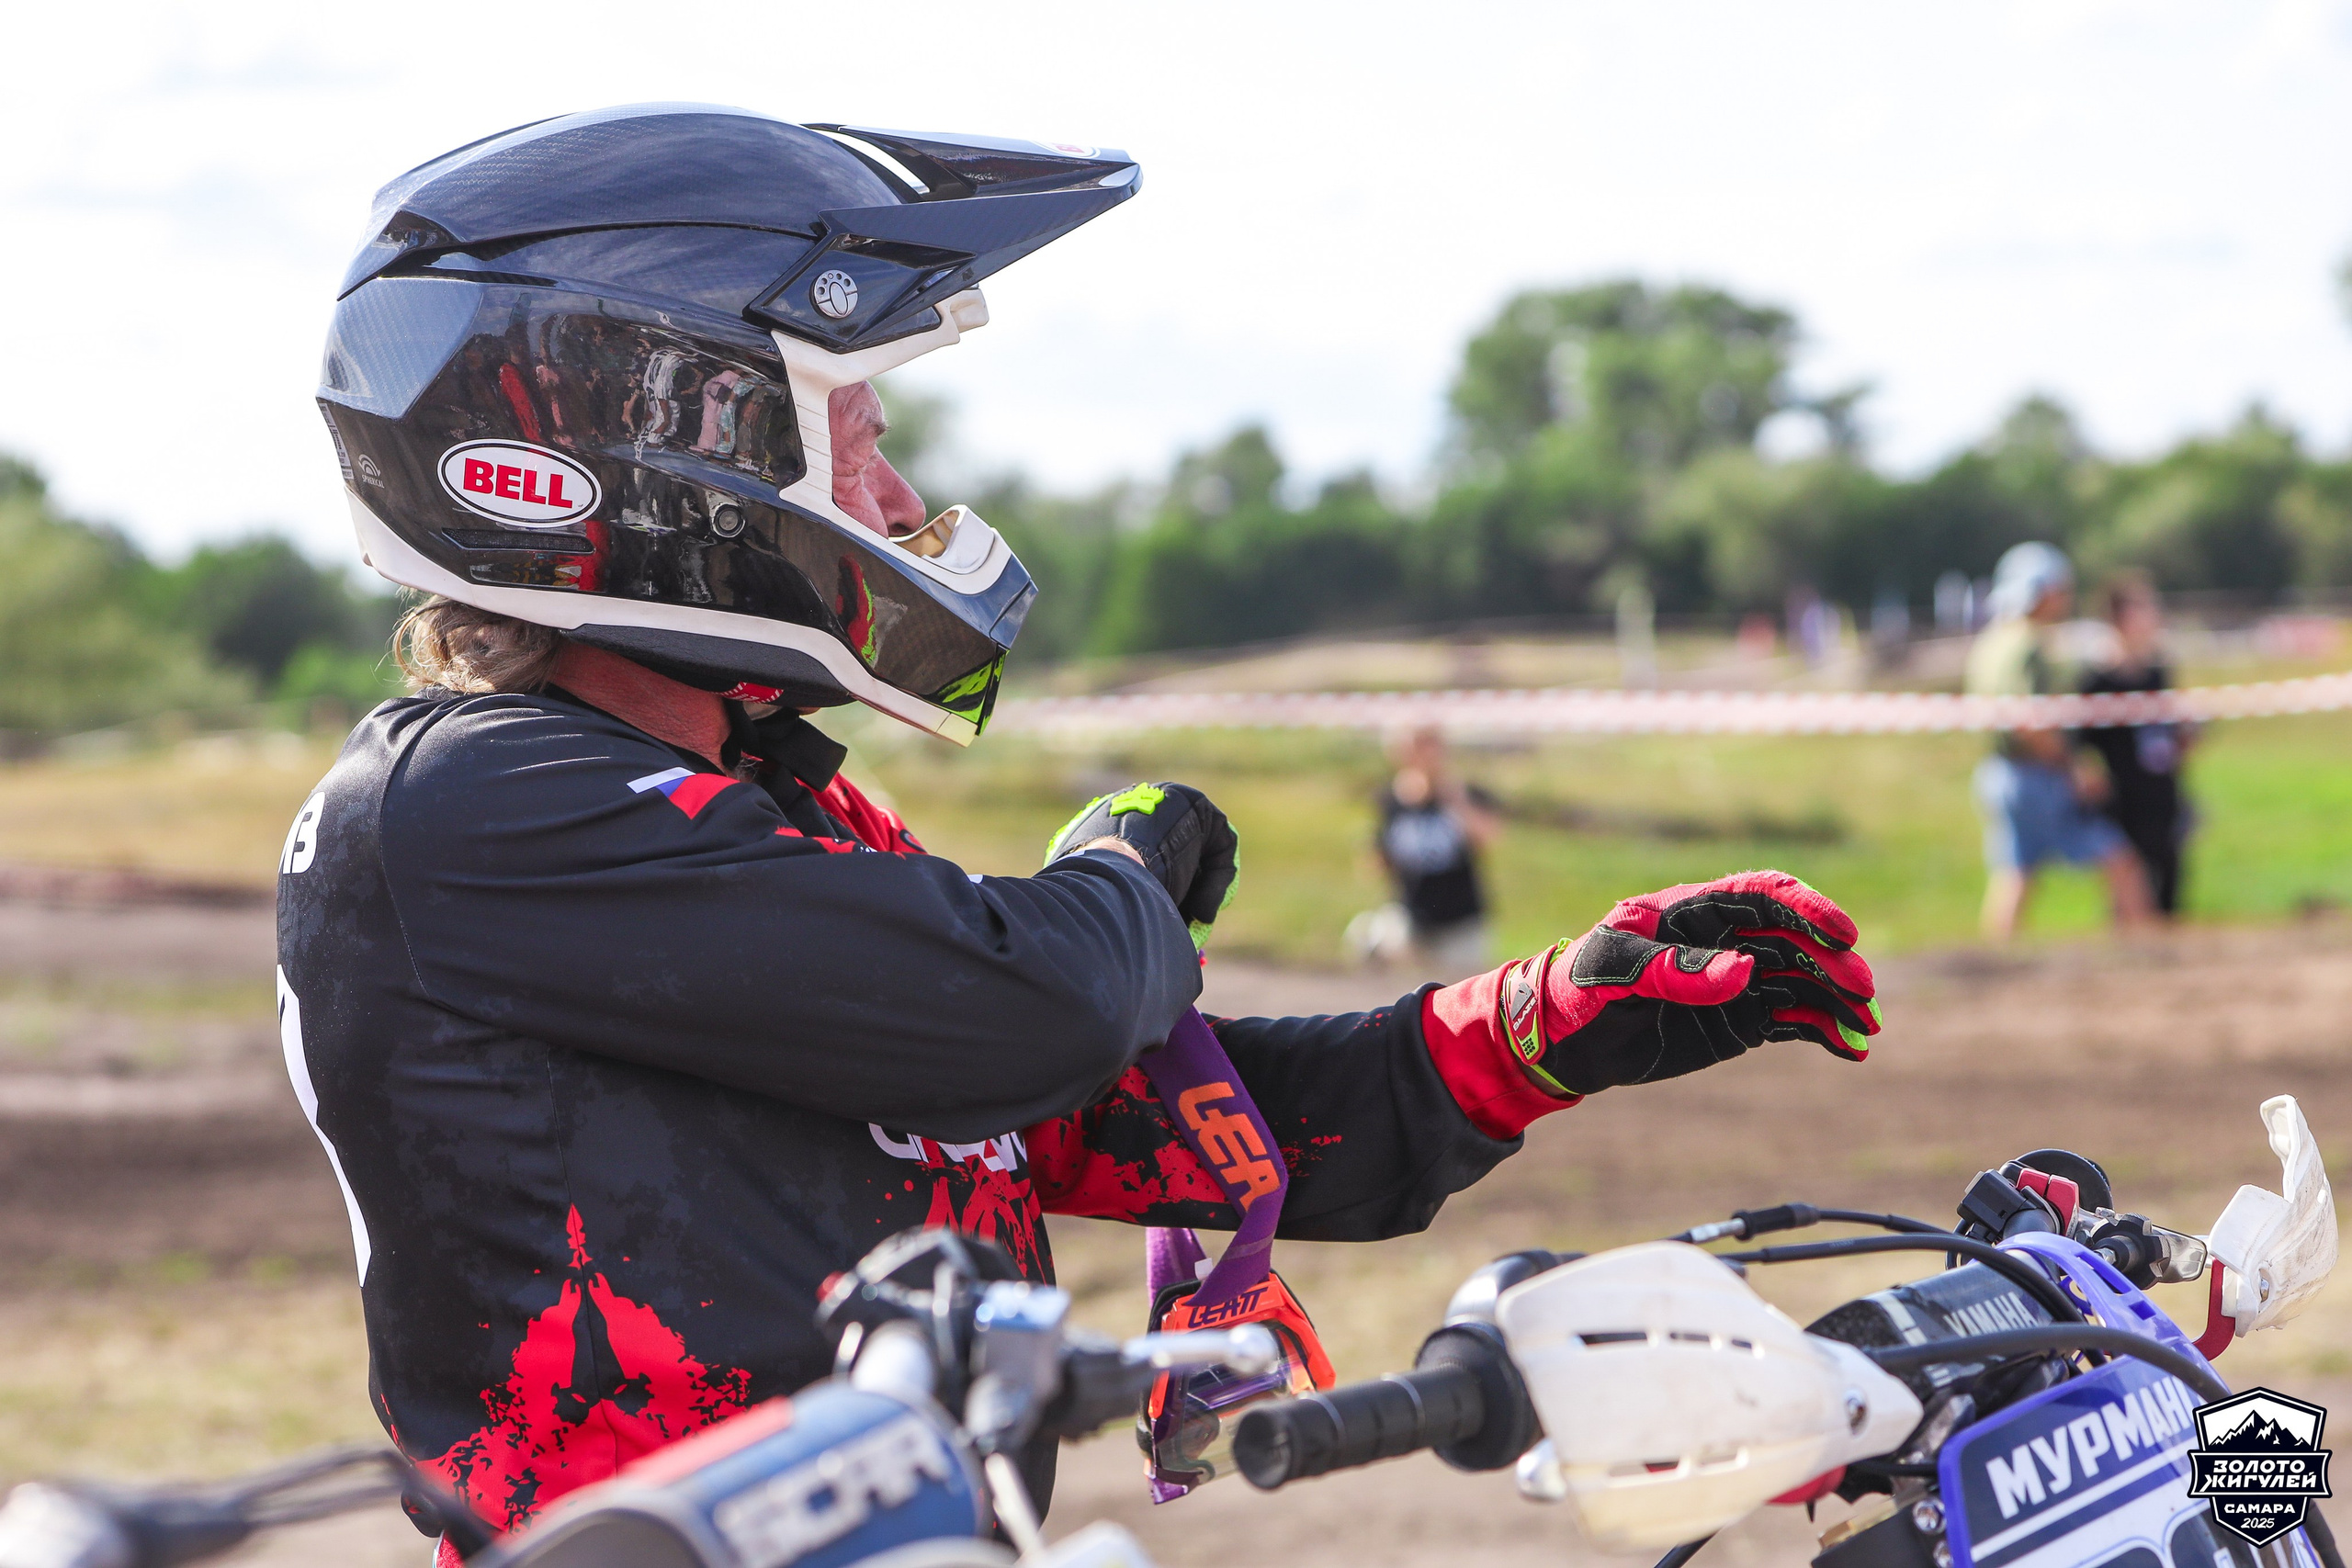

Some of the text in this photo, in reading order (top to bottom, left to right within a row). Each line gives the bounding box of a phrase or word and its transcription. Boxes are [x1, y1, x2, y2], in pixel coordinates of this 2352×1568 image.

[463, 457, 573, 509] BELL
[1188, 1287, 1269, 1329] LEATT
[1942, 1292, 2040, 1338] YAMAHA
